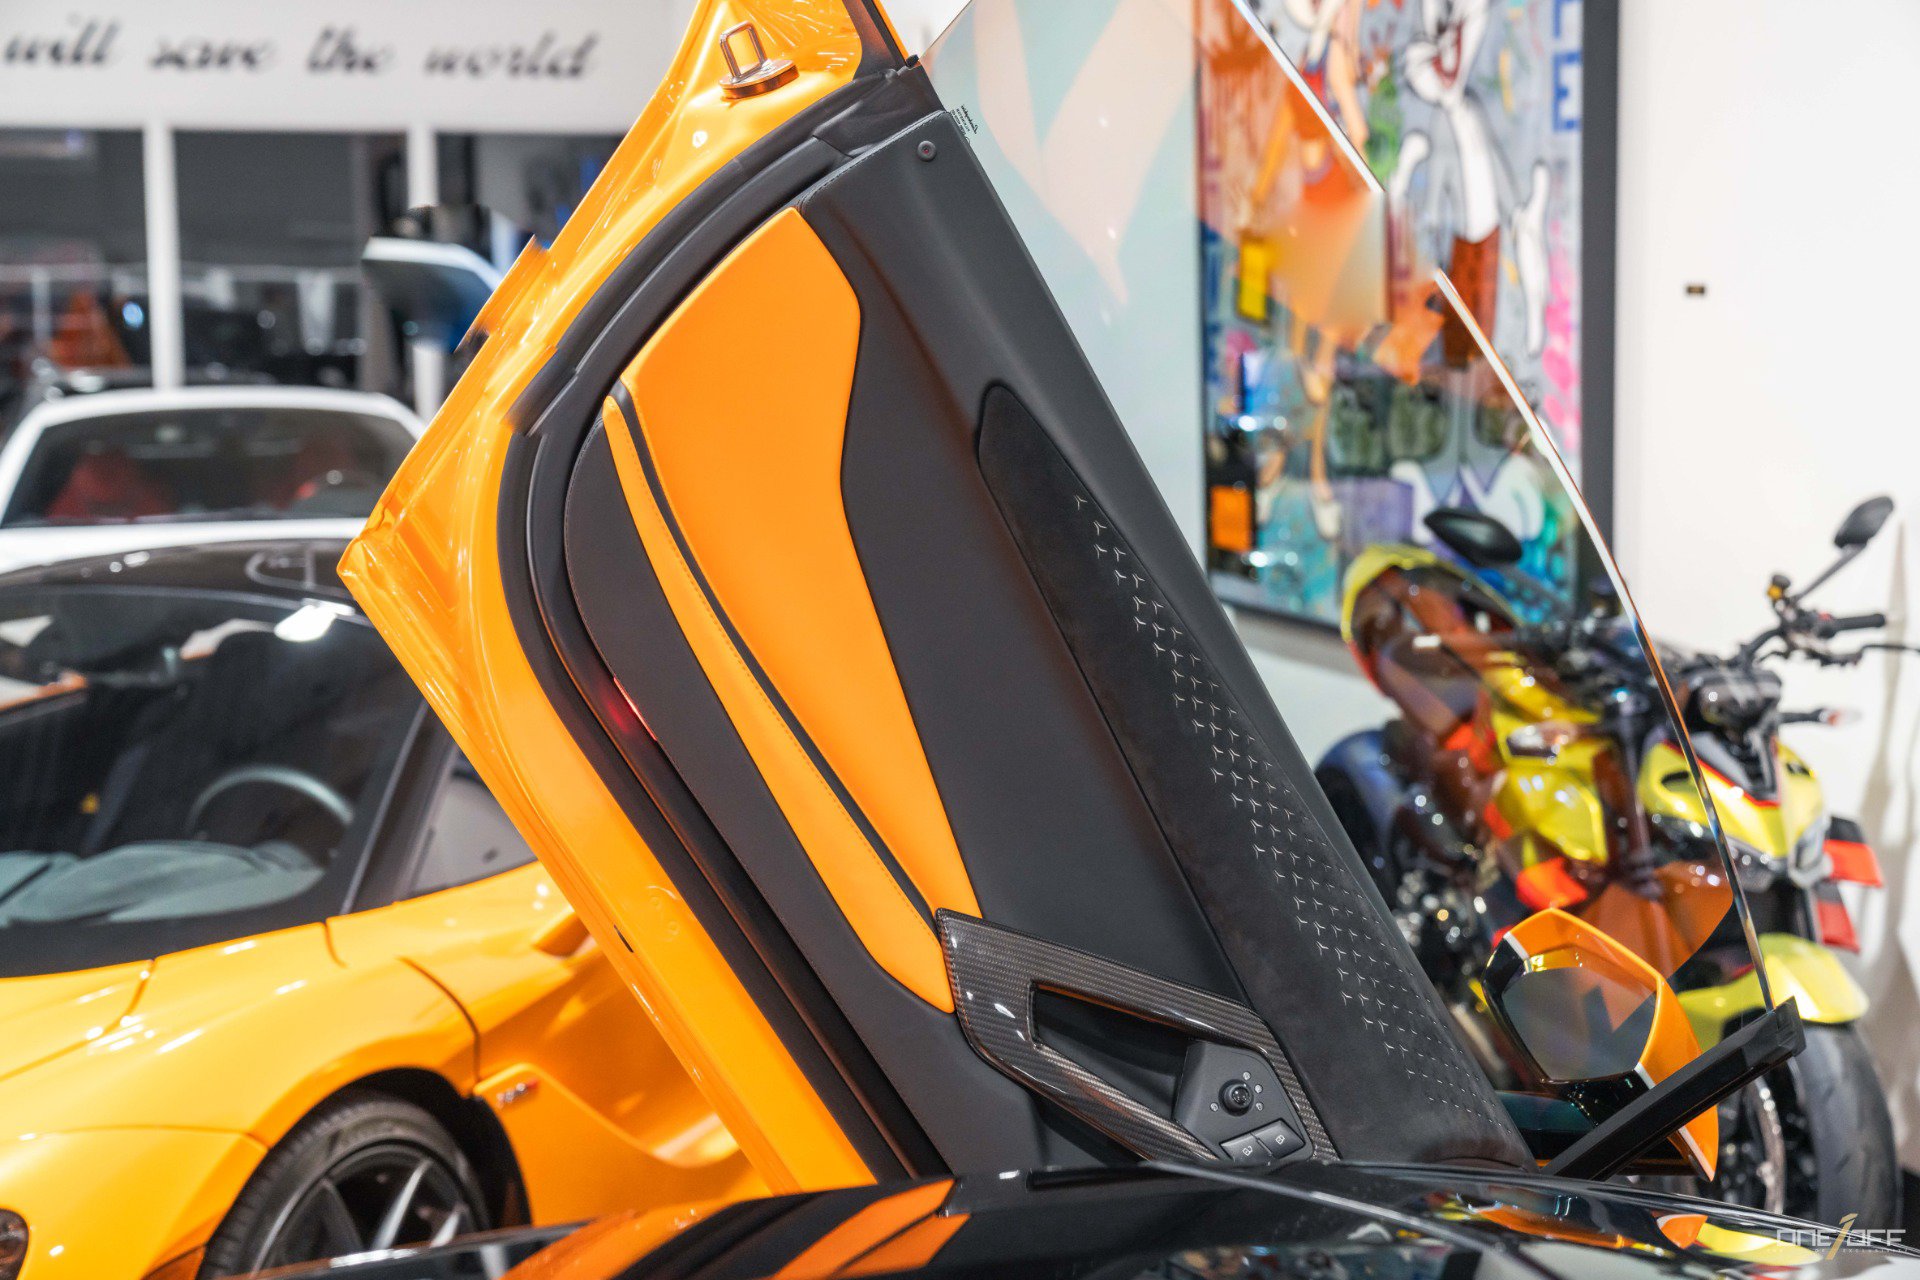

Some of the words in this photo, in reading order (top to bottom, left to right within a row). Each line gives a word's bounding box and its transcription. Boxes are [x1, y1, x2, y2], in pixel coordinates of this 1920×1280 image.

[4, 14, 120, 64] will
[306, 25, 394, 74] the
[422, 30, 601, 79] world
